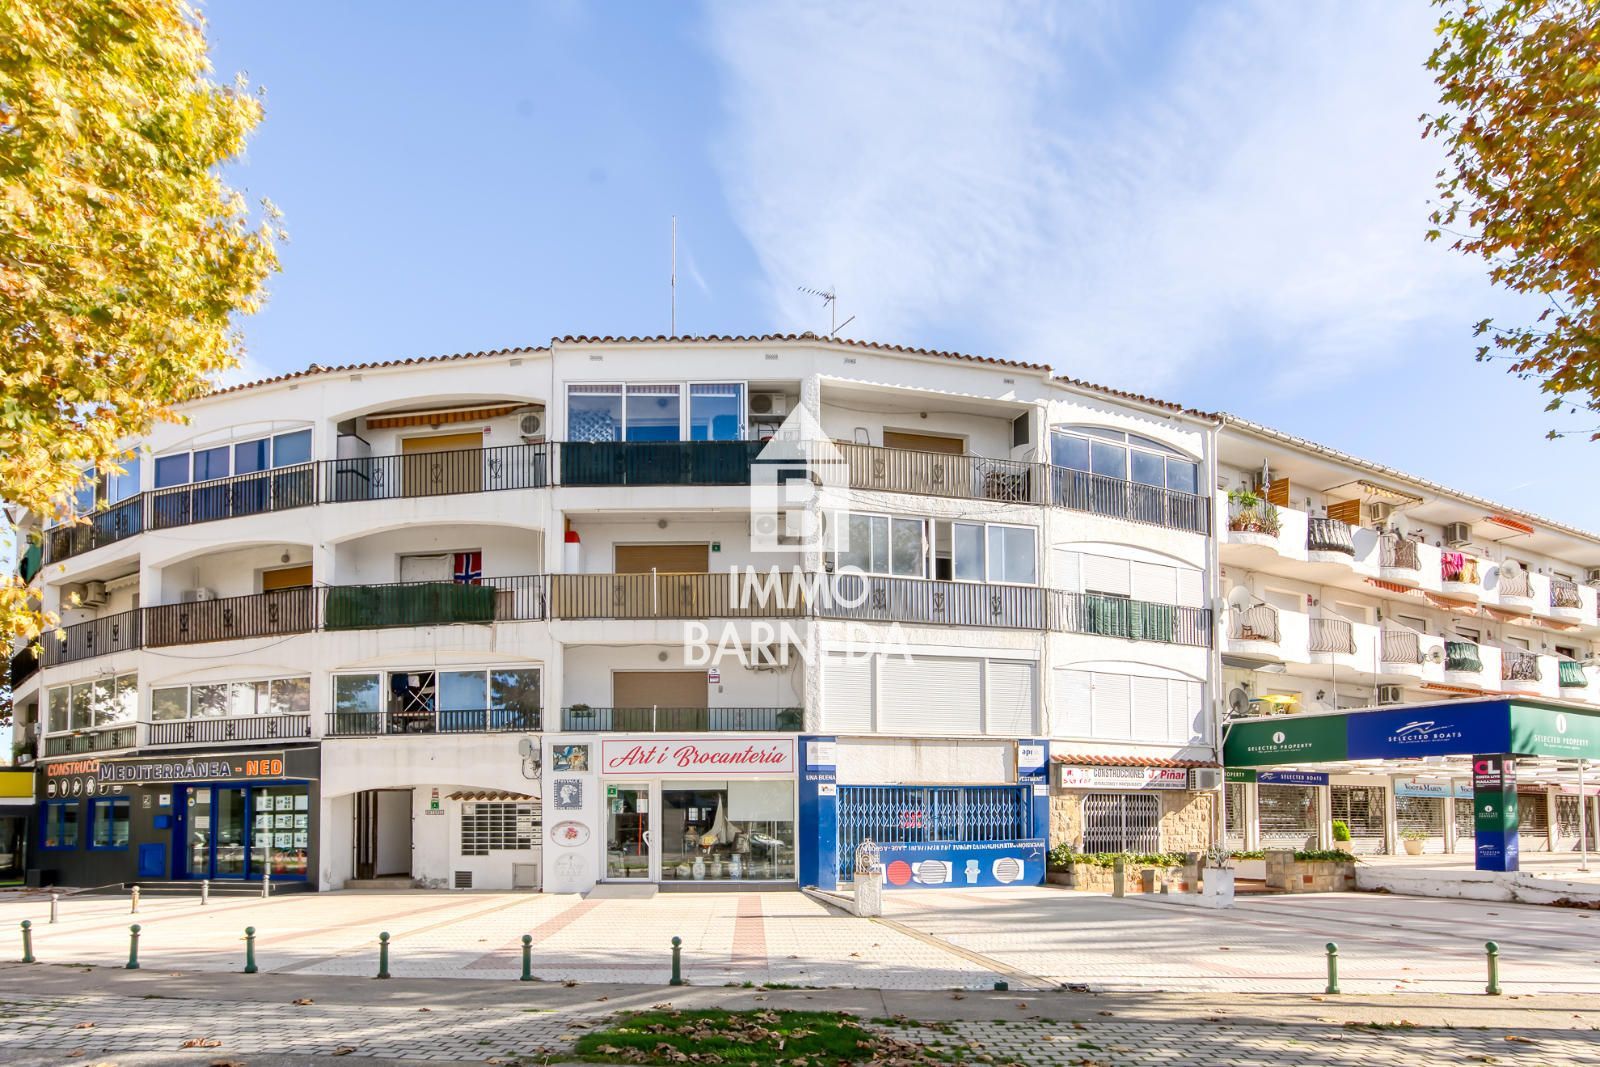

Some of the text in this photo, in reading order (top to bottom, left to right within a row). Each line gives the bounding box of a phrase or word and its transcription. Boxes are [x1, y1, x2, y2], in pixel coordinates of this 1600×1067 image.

[1388, 734, 1429, 742] SELECTED
[1434, 731, 1462, 739] BOATS
[1534, 735, 1561, 744] SELECTED
[1562, 737, 1589, 747] PROPERTY
[1280, 742, 1313, 750] PROPERTY
[609, 745, 657, 768] Art
[673, 745, 787, 768] Brocanteria
[98, 758, 232, 782] MEDITERRÁNEA
[245, 759, 283, 776] NED
[1093, 768, 1145, 779] CONSTRUCCIONES
[1474, 760, 1501, 775] CL
